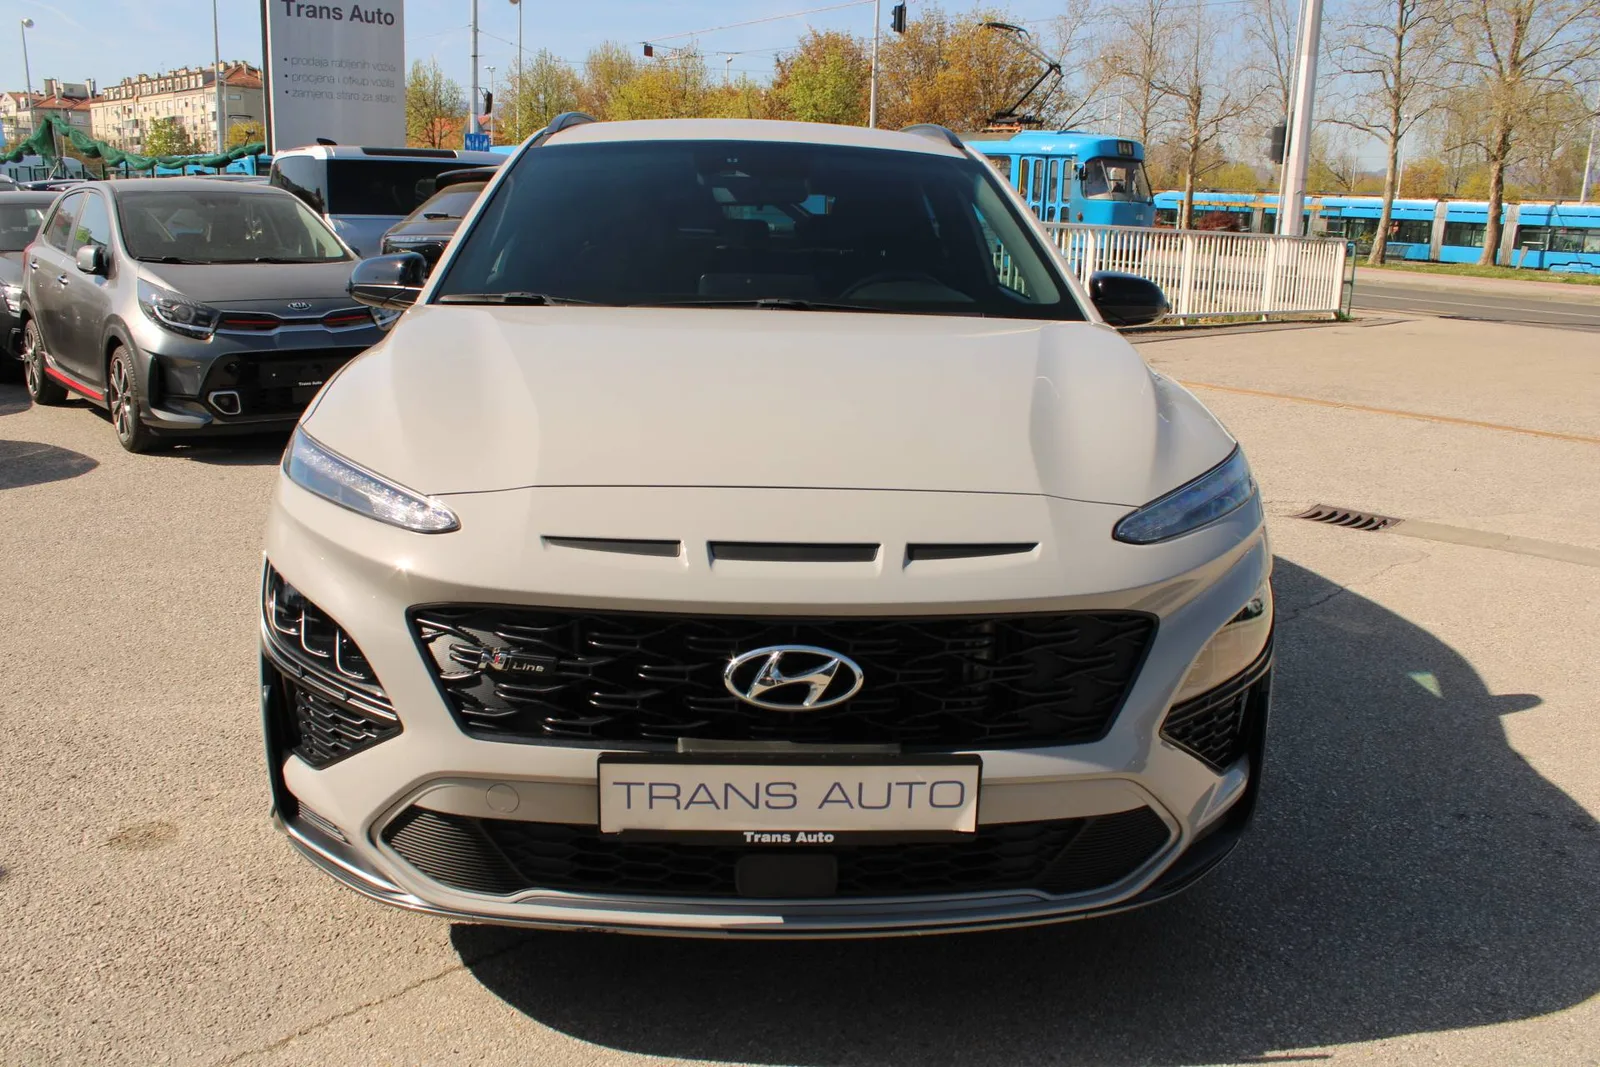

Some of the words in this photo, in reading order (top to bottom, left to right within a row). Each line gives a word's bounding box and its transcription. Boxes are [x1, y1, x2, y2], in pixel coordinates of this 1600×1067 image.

[281, 0, 343, 20] Trans
[349, 4, 395, 25] Auto
[291, 56, 329, 68] prodaja
[291, 73, 335, 85] procjena
[291, 89, 334, 100] zamjena
[512, 661, 545, 672] Line
[612, 781, 797, 810] TRANS
[817, 780, 965, 810] AUTO
[743, 831, 791, 843] Trans
[795, 831, 835, 843] Auto
